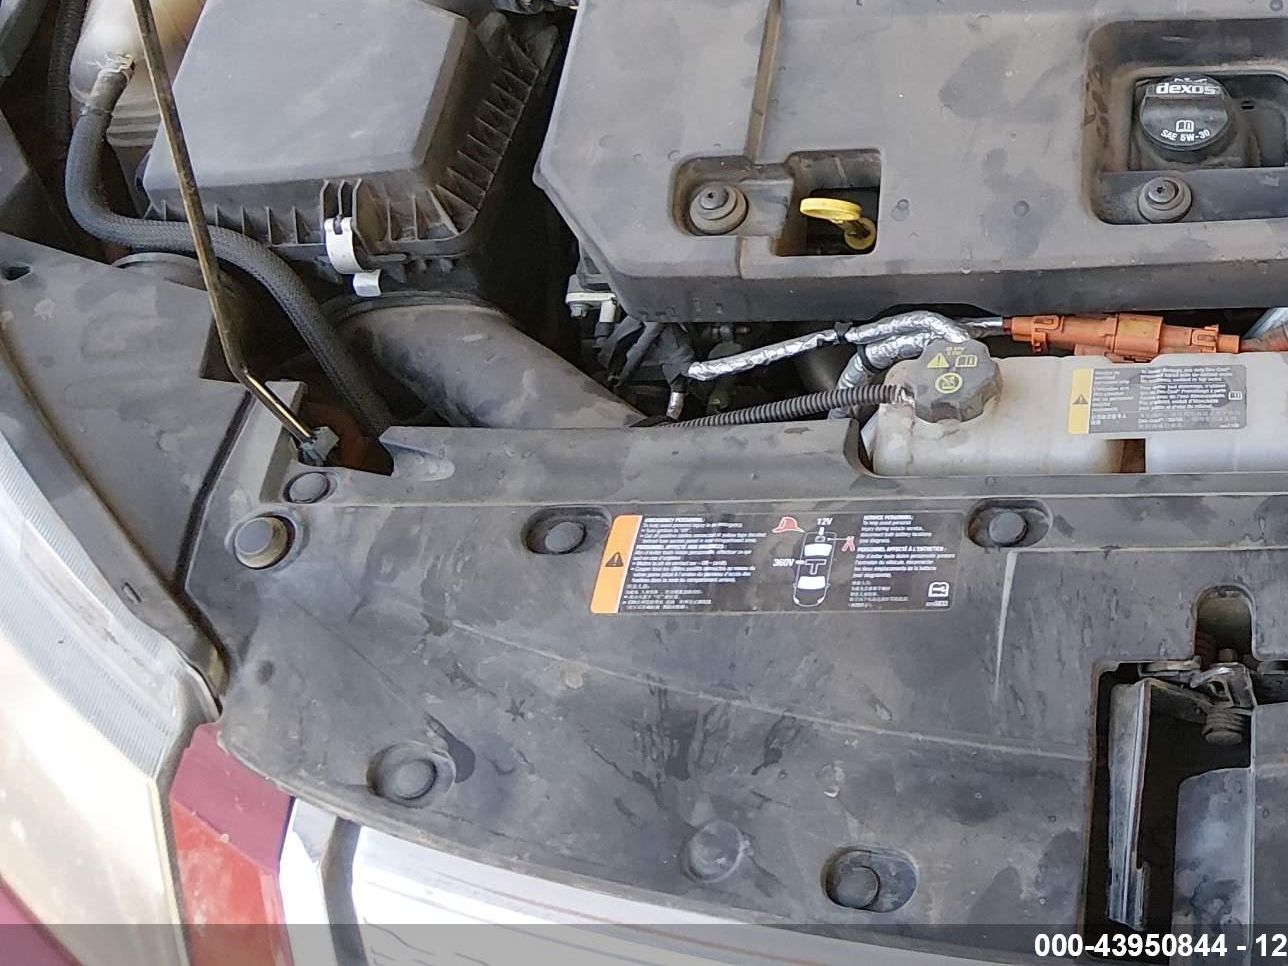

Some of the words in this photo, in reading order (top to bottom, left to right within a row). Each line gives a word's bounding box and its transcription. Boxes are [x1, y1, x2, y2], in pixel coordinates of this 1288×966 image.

[1156, 82, 1218, 95] dexos
[1160, 129, 1178, 141] SAE
[1180, 129, 1211, 142] 5W-30
[816, 517, 833, 525] 12V
[772, 558, 795, 567] 360V
